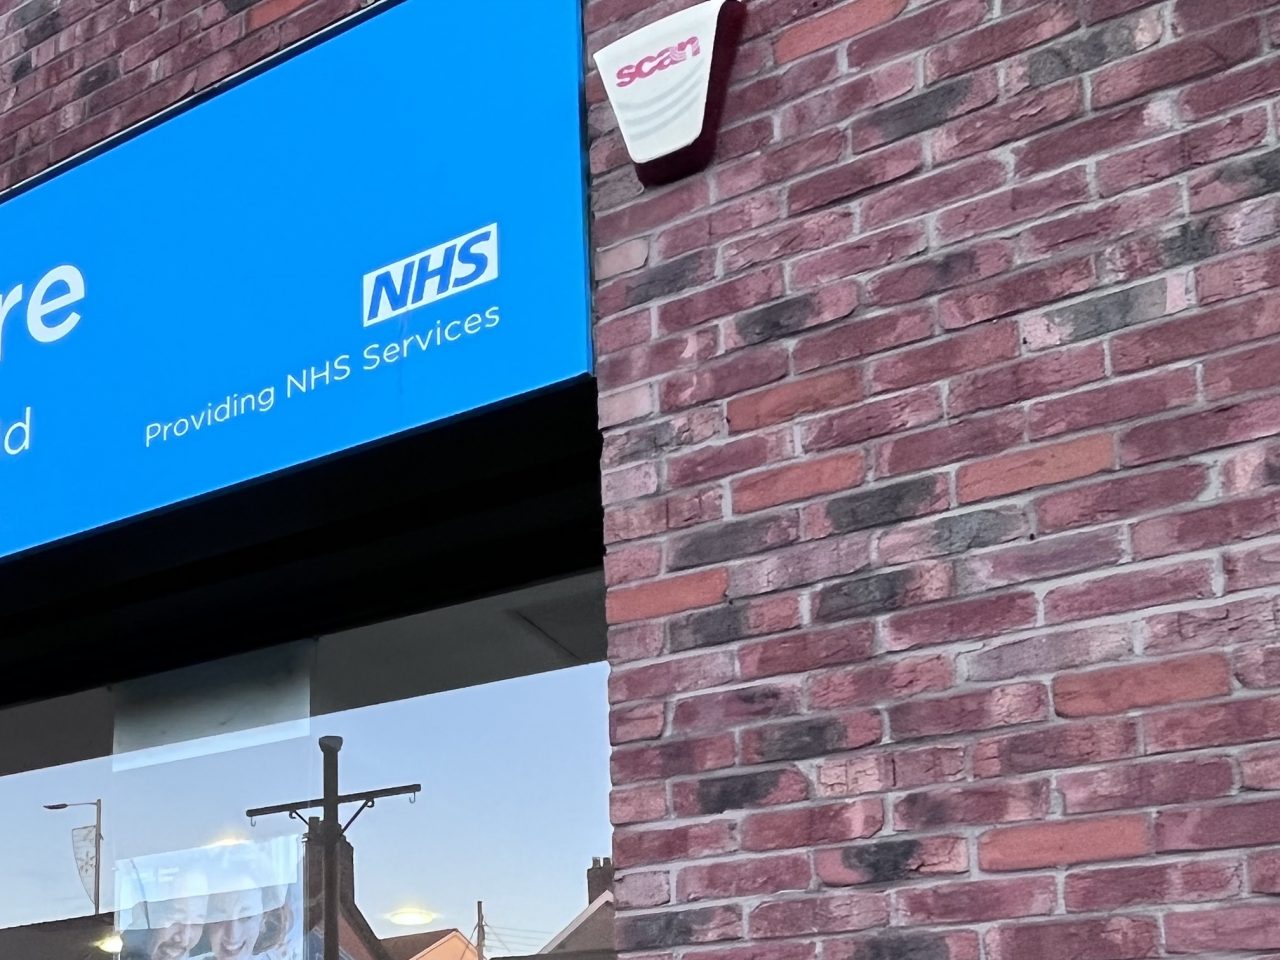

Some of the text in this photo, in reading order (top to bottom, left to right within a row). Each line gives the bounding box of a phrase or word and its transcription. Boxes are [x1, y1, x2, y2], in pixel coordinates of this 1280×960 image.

[616, 36, 701, 87] scan
[366, 230, 492, 322] NHS
[145, 305, 500, 447] Providing NHS Services
